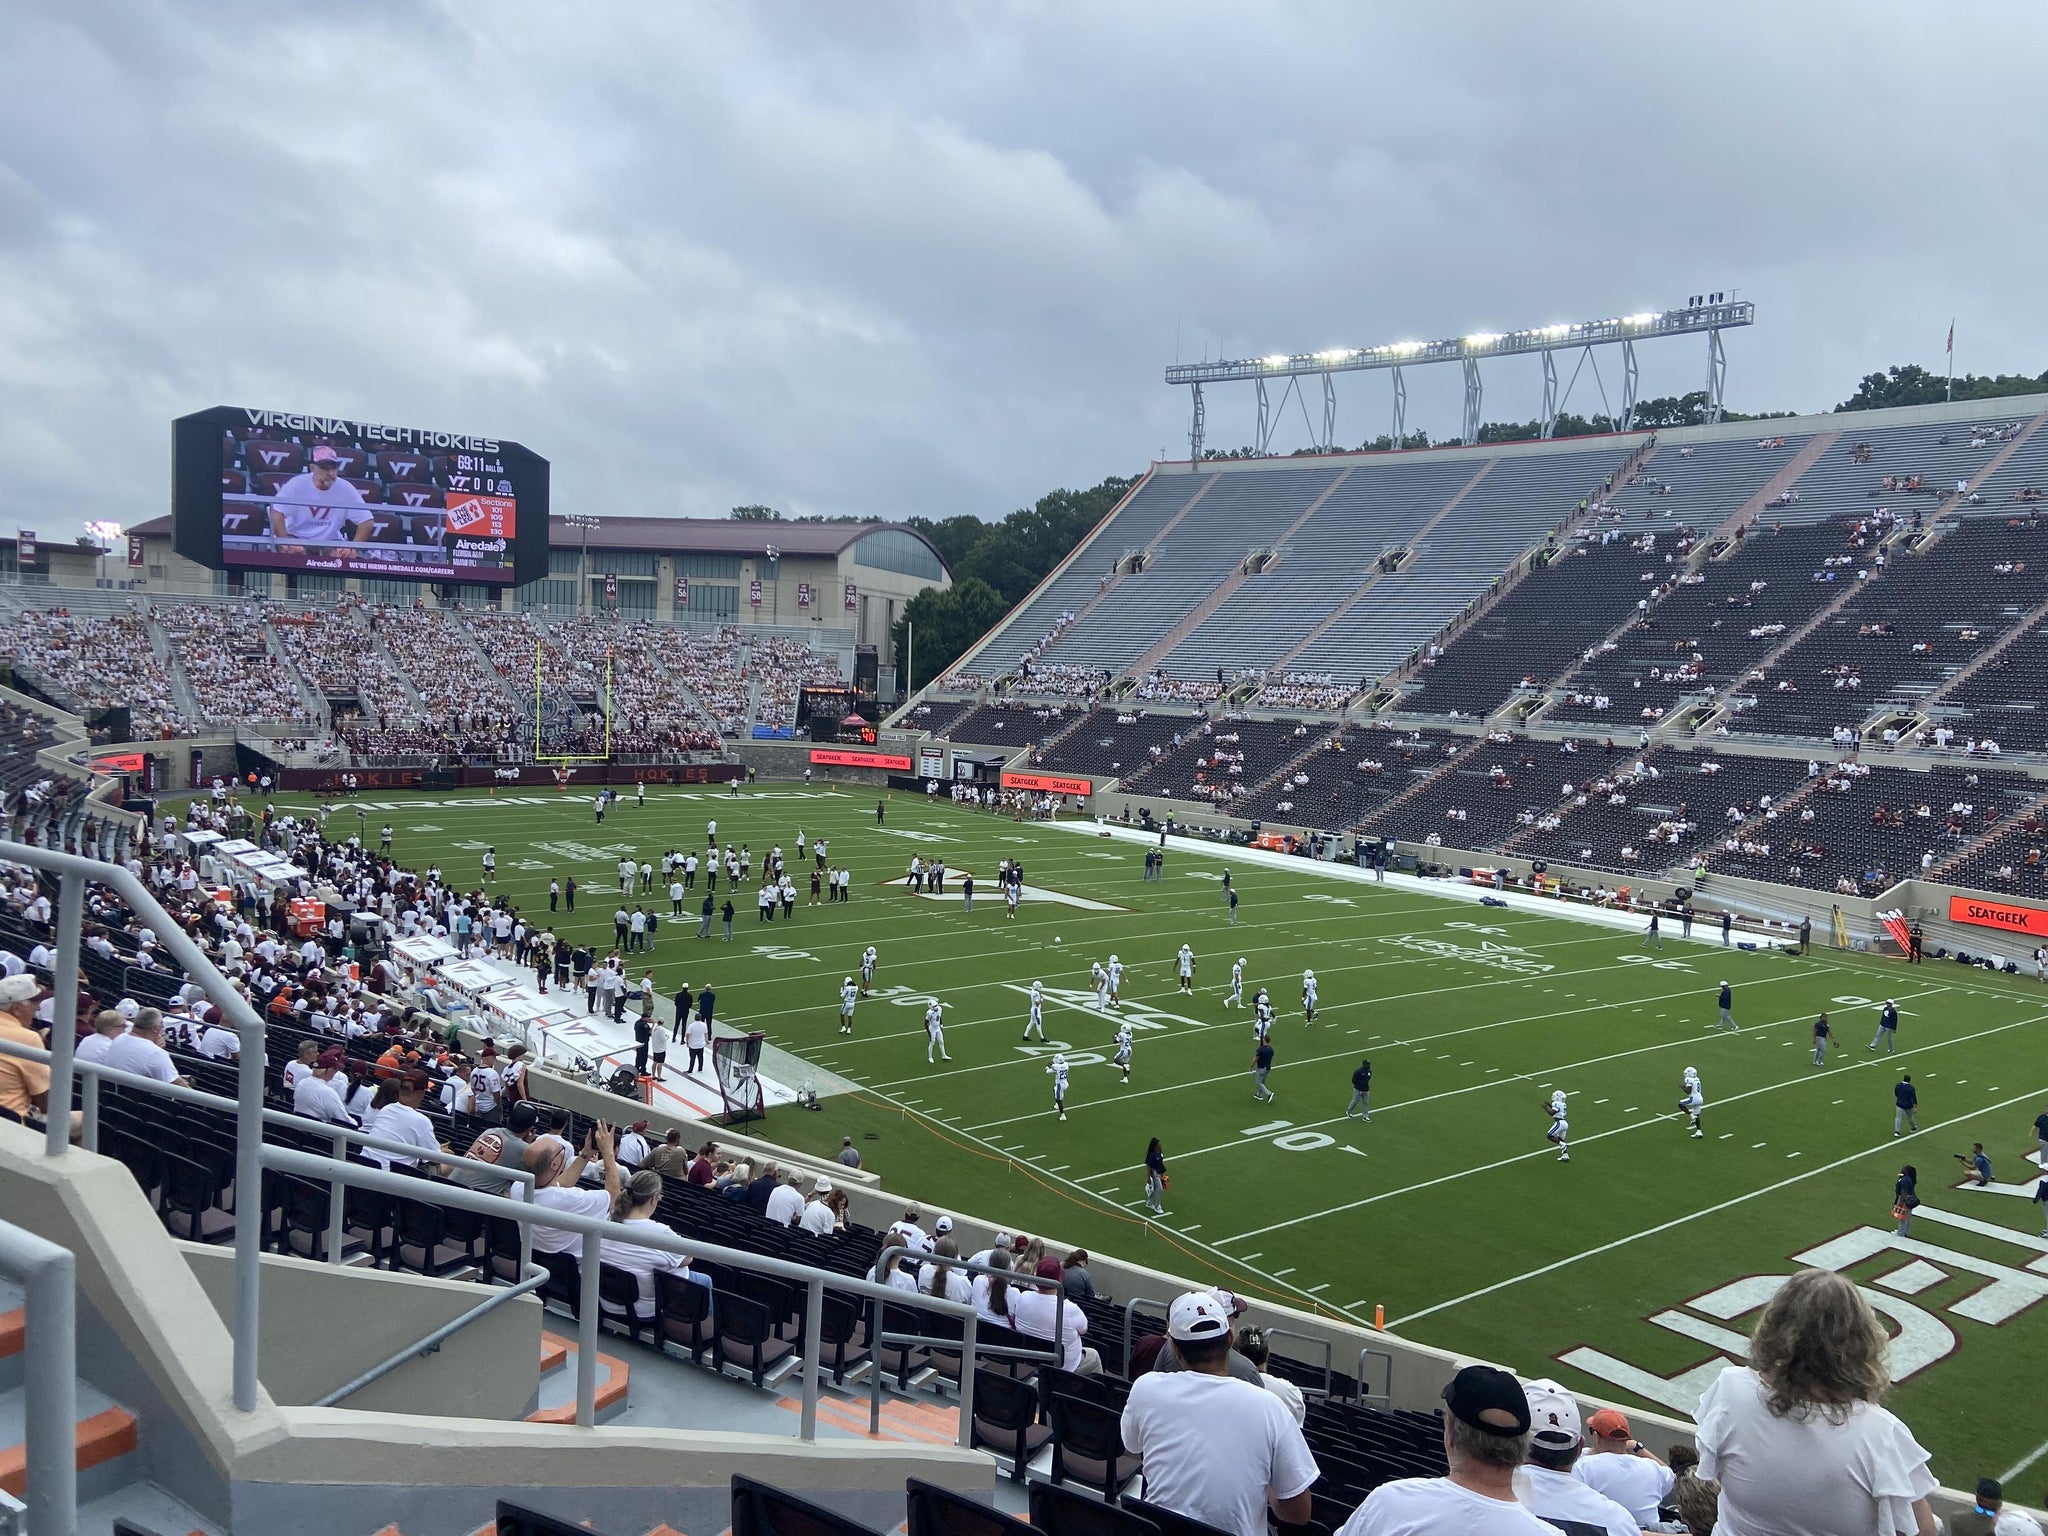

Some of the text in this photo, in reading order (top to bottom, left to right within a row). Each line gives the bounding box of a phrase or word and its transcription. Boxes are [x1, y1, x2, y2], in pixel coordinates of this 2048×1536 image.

[243, 408, 500, 453] VIRGINIA TECH HOKIES
[458, 454, 484, 472] 69:11
[448, 475, 470, 487] VT
[474, 478, 480, 490] 0
[488, 479, 494, 492] 0
[481, 498, 512, 508] Sections
[454, 506, 468, 515] THE
[452, 510, 471, 523] LANE
[460, 516, 474, 526] LEG
[456, 539, 499, 552] Airedale
[132, 548, 140, 560] 7
[453, 549, 472, 558] FLORIDA
[306, 560, 338, 568] Airedale
[368, 562, 388, 570] HIRING
[388, 564, 454, 575] AIREDALE.COM/CAREERS
[606, 584, 616, 592] 64
[678, 588, 687, 597] 56
[752, 590, 761, 600] 58
[798, 592, 808, 602] 73
[846, 594, 856, 603] 78
[862, 732, 874, 742] 40
[635, 768, 708, 779] HOKES
[1010, 776, 1038, 786] SEATGEEK
[1052, 780, 1082, 790] SEATGEEK
[1968, 906, 2028, 927] SEATGEEK
[166, 1024, 192, 1045] 34
[1060, 1070, 1068, 1080] 23
[472, 1074, 486, 1092] 25
[1240, 1120, 1336, 1152] 10
